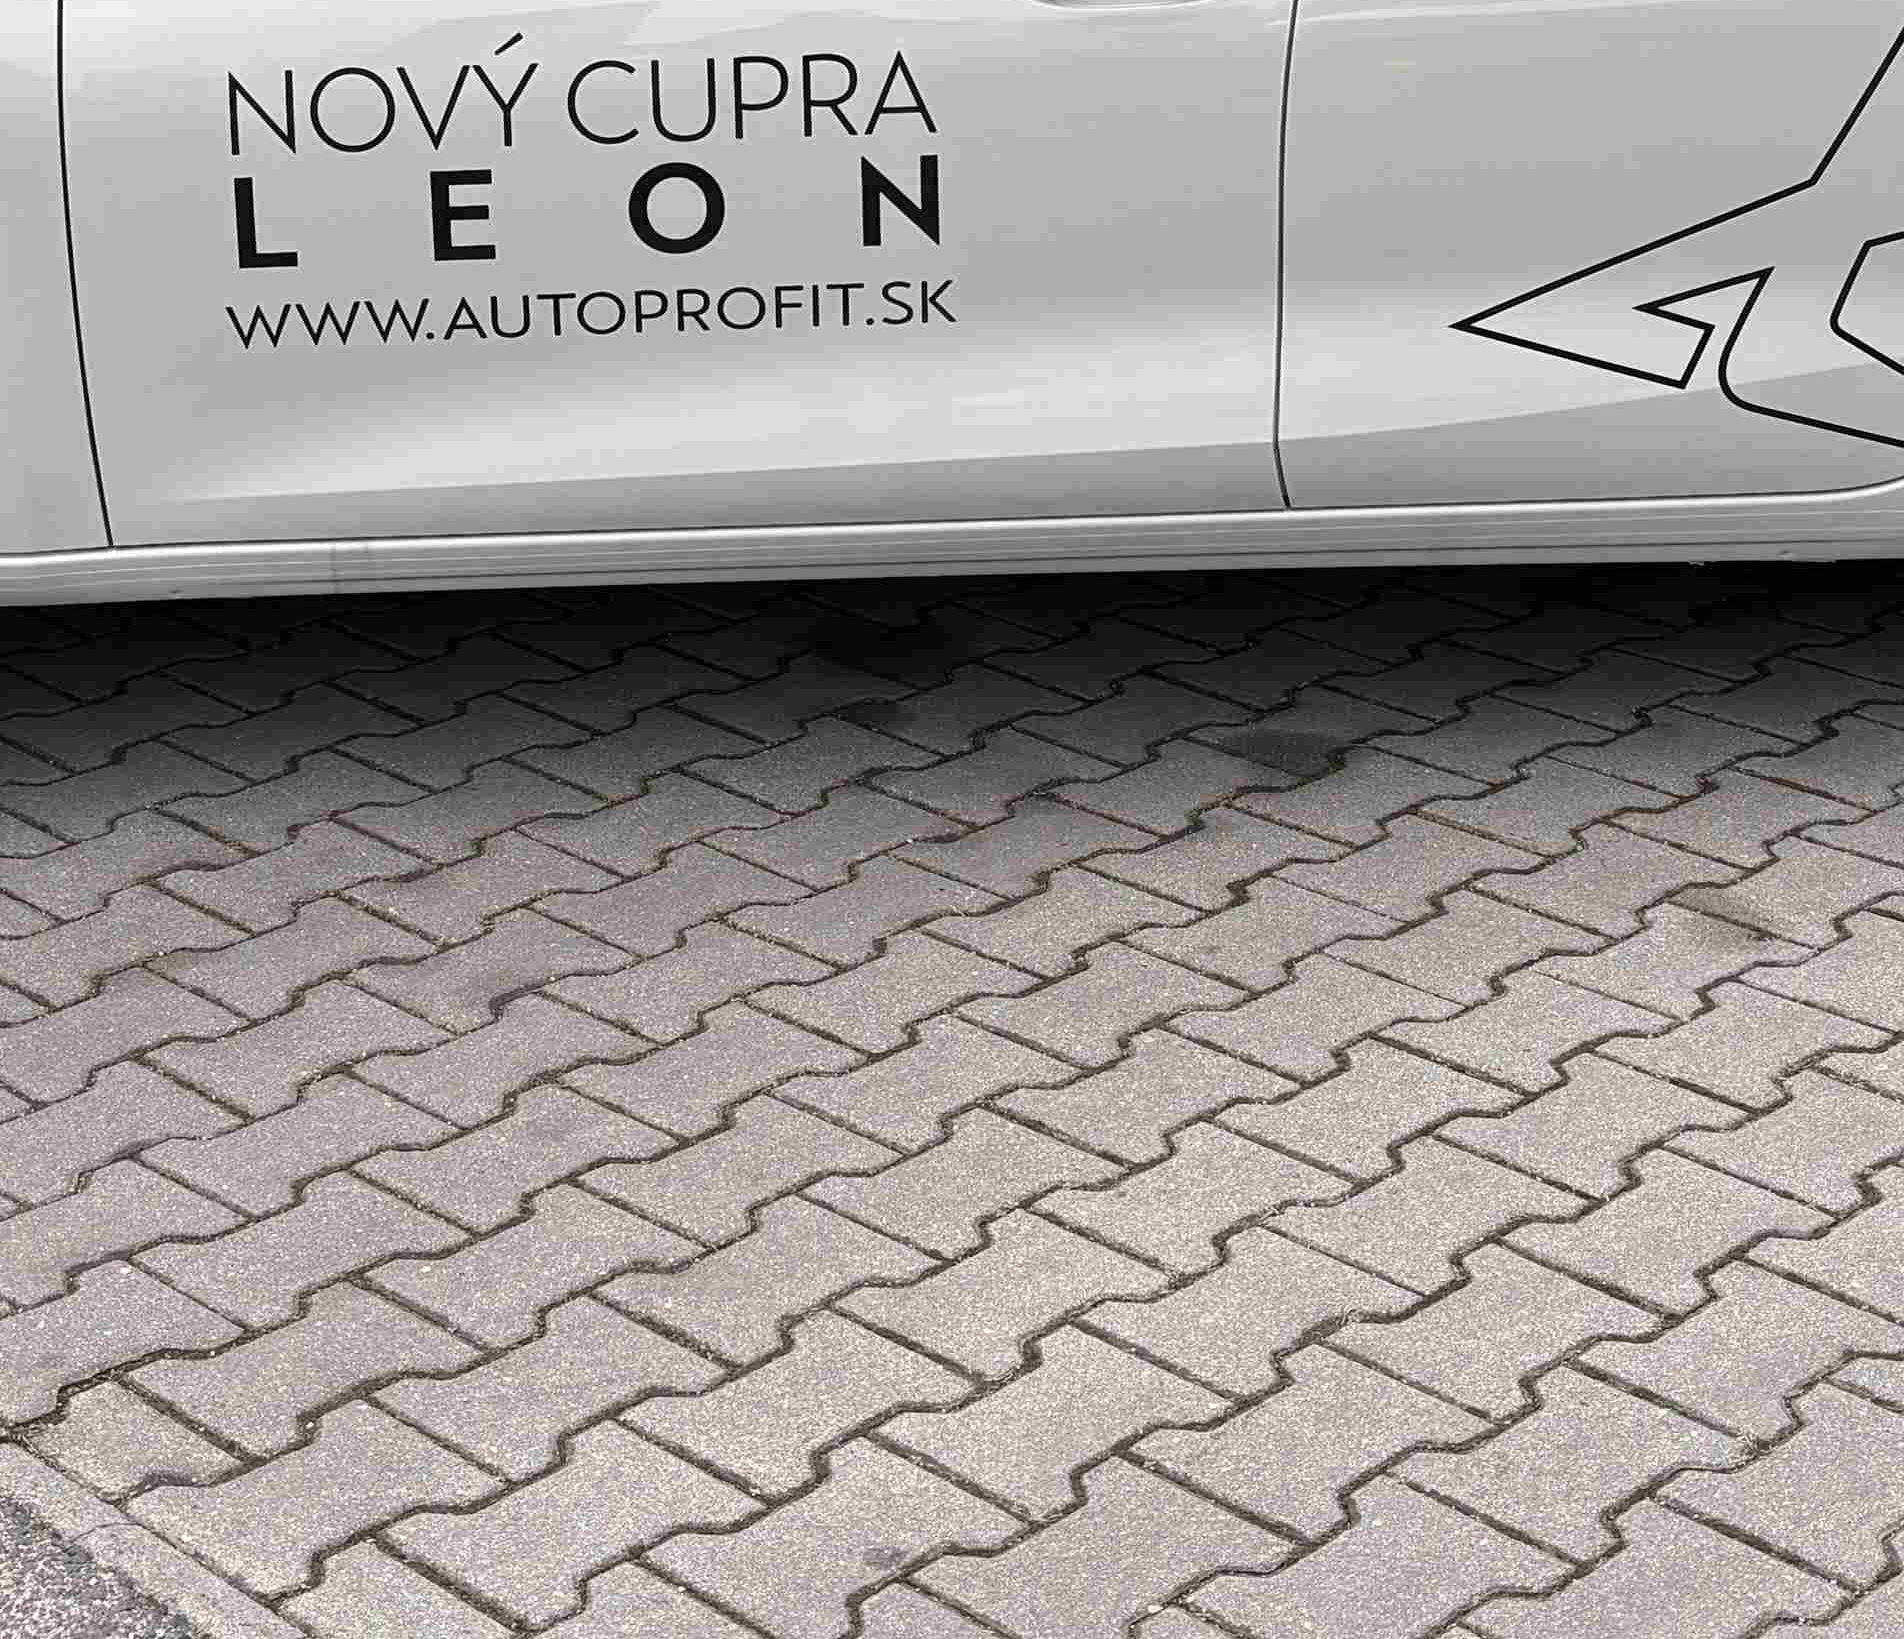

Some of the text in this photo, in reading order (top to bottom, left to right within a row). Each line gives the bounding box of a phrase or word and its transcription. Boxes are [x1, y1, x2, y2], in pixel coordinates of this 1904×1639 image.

[228, 32, 937, 156] NOVÝ CUPRA
[233, 154, 941, 269] LEON
[225, 279, 958, 350] WWW.AUTOPROFIT.SK
